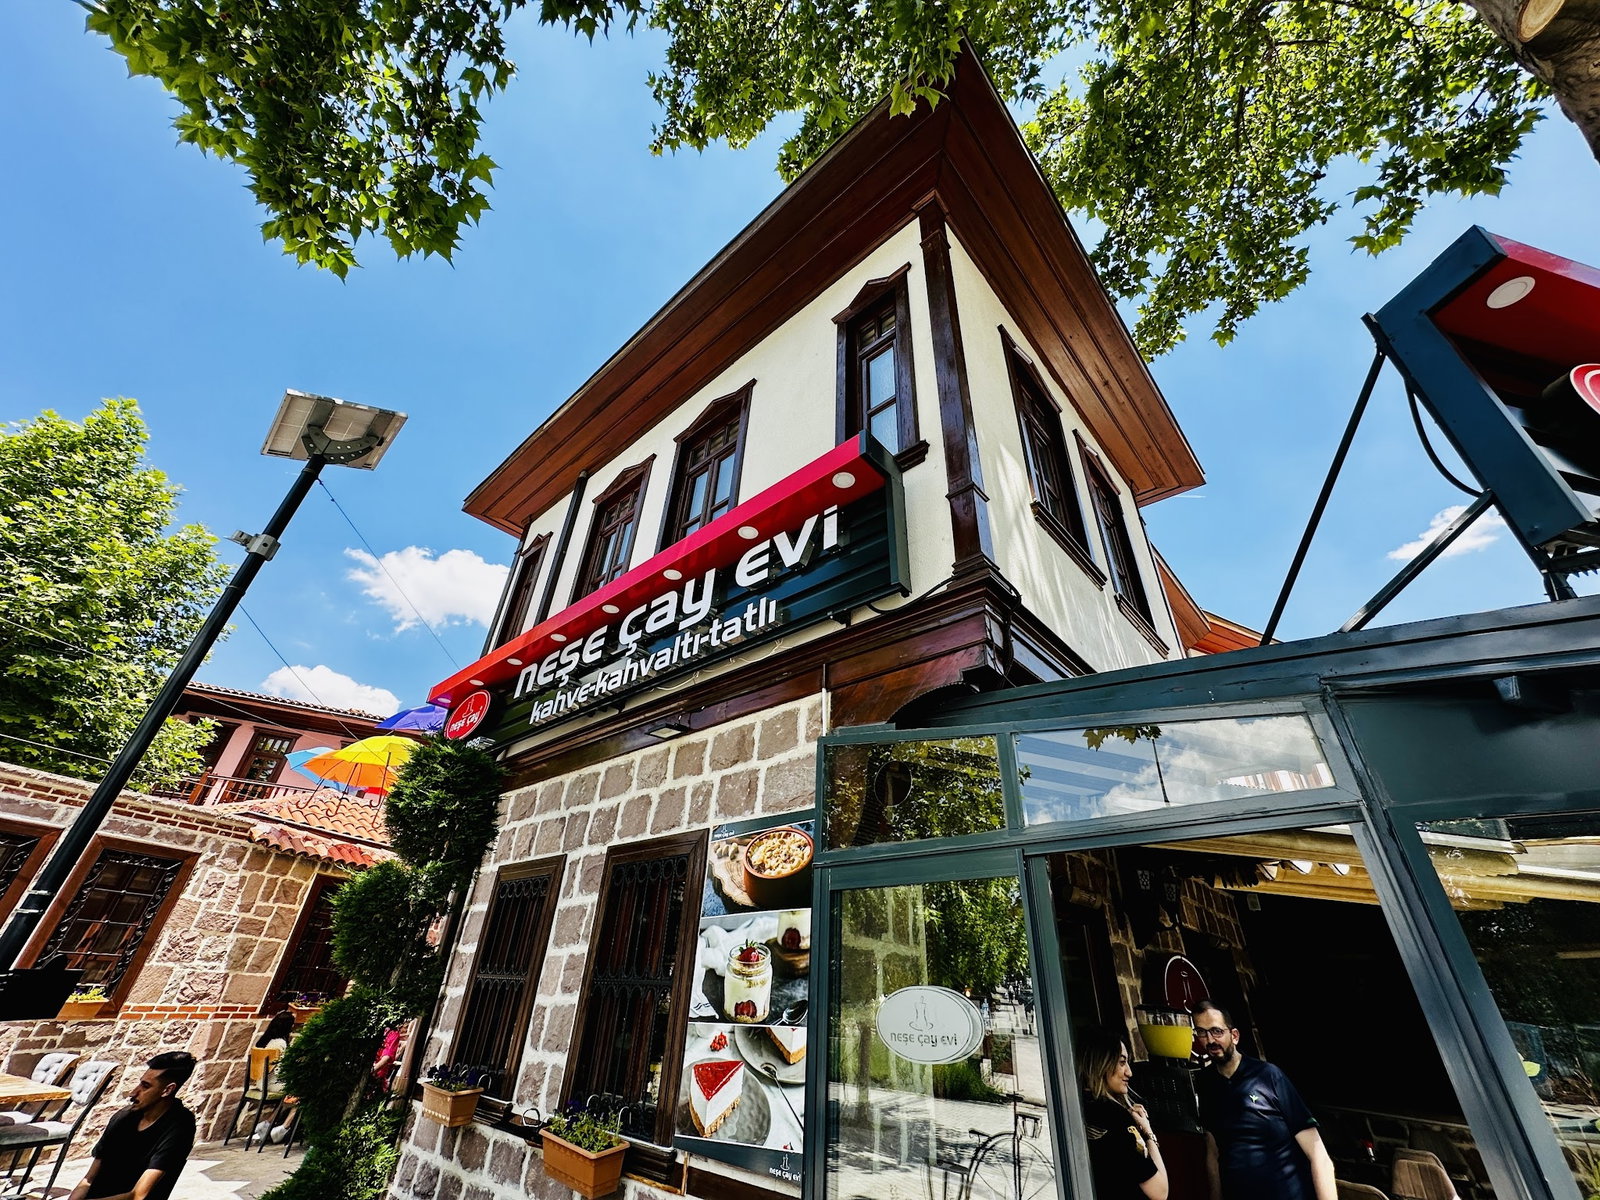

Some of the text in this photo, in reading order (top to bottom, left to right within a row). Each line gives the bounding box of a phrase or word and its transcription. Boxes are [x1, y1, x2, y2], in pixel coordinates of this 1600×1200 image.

[513, 504, 838, 699] neşe çay evi
[890, 1032, 958, 1047] neşe çay evi
